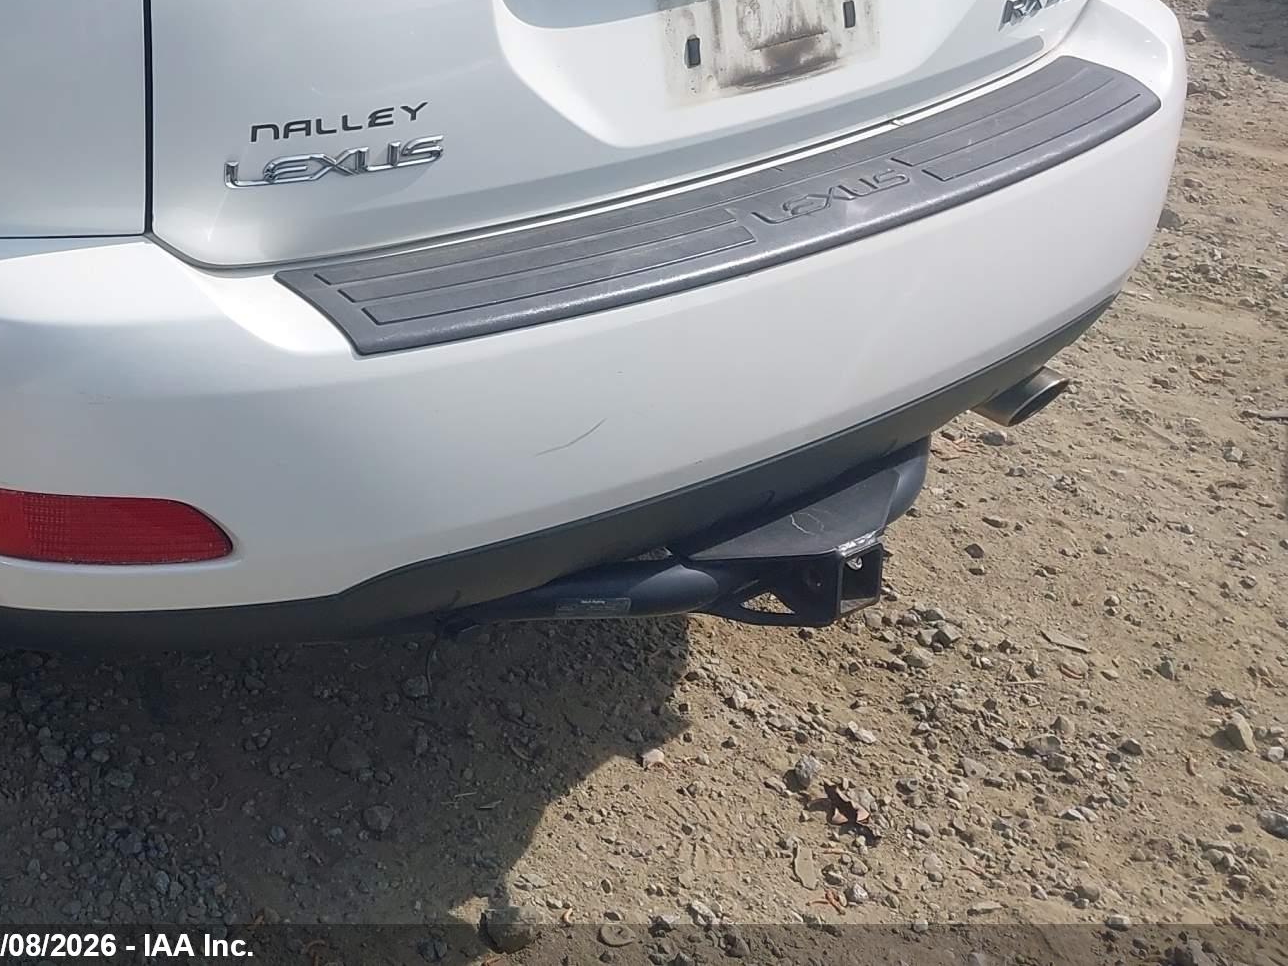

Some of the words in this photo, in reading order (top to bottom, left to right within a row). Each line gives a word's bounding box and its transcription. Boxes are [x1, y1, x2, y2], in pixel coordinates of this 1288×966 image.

[249, 101, 429, 143] NALLEY
[223, 134, 445, 189] LEXUS
[750, 167, 911, 225] LEXUS
